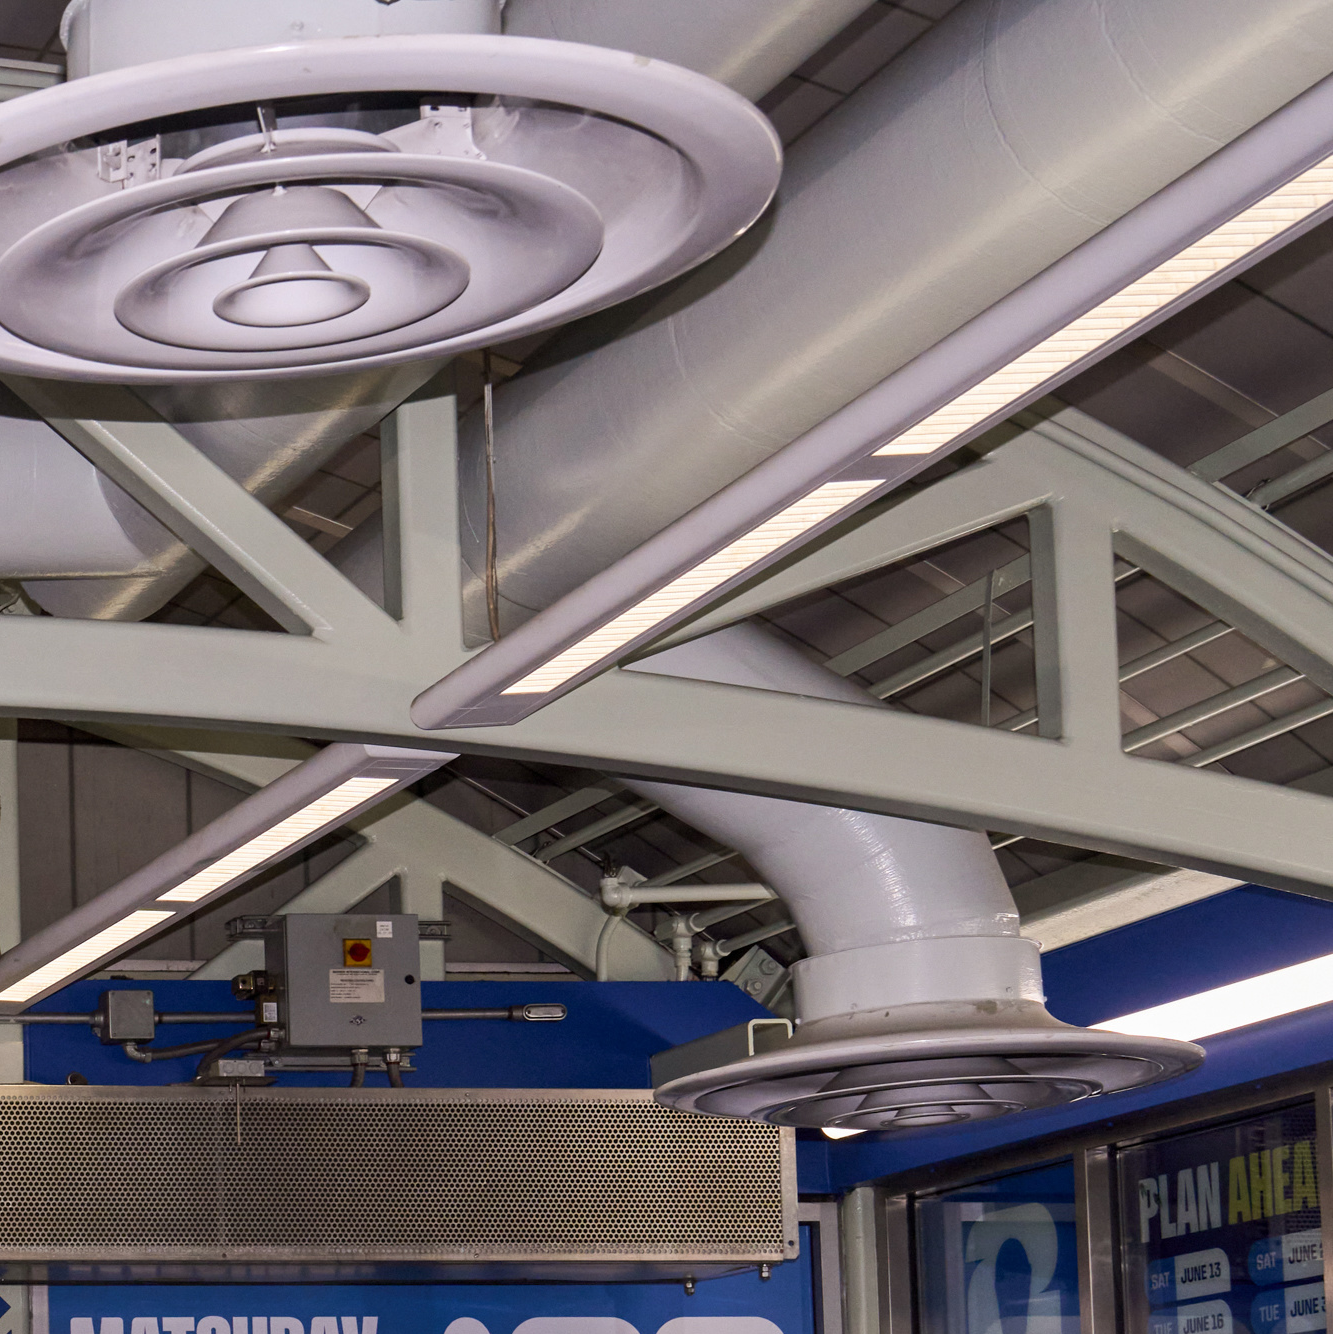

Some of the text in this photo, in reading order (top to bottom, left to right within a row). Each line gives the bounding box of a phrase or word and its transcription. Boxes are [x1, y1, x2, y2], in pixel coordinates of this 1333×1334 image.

[1138, 1141, 1320, 1243] PLAN AHEA
[1256, 1252, 1276, 1270] SAT
[1289, 1244, 1317, 1264] JUNE
[1151, 1272, 1170, 1290] SAT
[1181, 1262, 1221, 1283] JUNE 13
[1259, 1305, 1279, 1322] TUE
[1290, 1299, 1319, 1317] JUNE
[1183, 1314, 1224, 1334] JUNE 16
